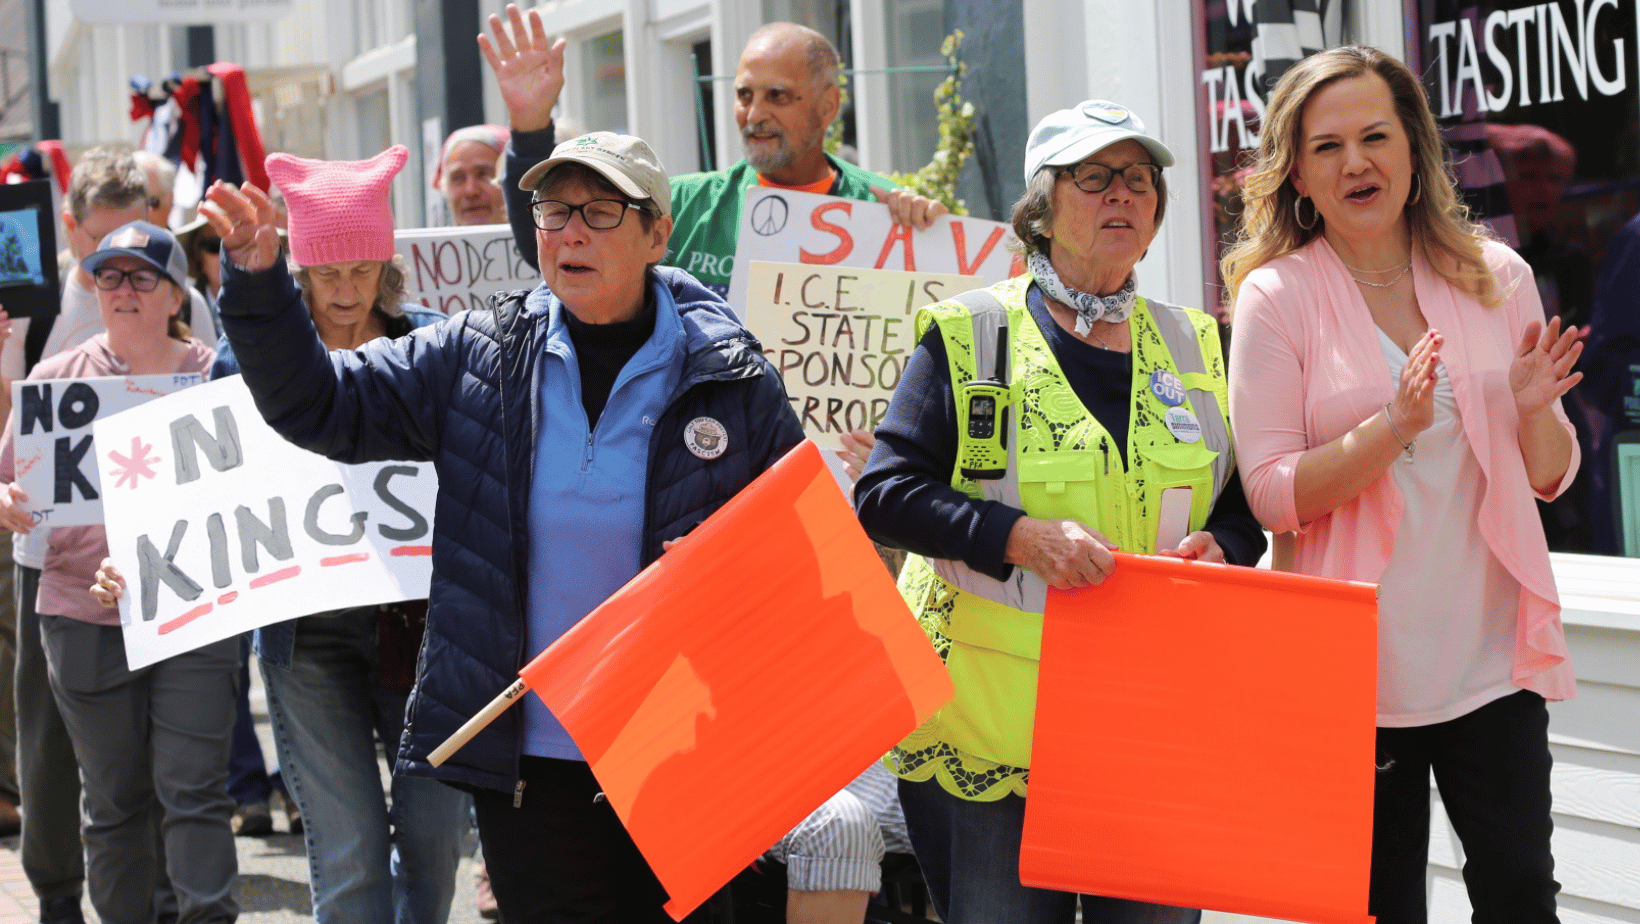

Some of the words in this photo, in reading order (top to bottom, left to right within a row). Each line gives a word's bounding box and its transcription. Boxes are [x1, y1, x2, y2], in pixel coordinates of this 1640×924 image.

[1429, 0, 1627, 118] TASTING
[1201, 60, 1266, 153] TAS
[799, 201, 1029, 279] SAV
[411, 240, 463, 292] NO
[462, 237, 542, 288] DETE
[773, 272, 866, 312] I.C.E.
[781, 311, 905, 354] STATE
[762, 348, 911, 391] PONSO
[1157, 371, 1183, 392] ICE
[20, 382, 100, 436] NO
[1153, 382, 1185, 403] OUT
[641, 415, 657, 427] Ro
[787, 396, 891, 434] RROR
[689, 441, 721, 457] FASCISM
[31, 508, 55, 525] DT
[136, 465, 430, 622] KINGS
